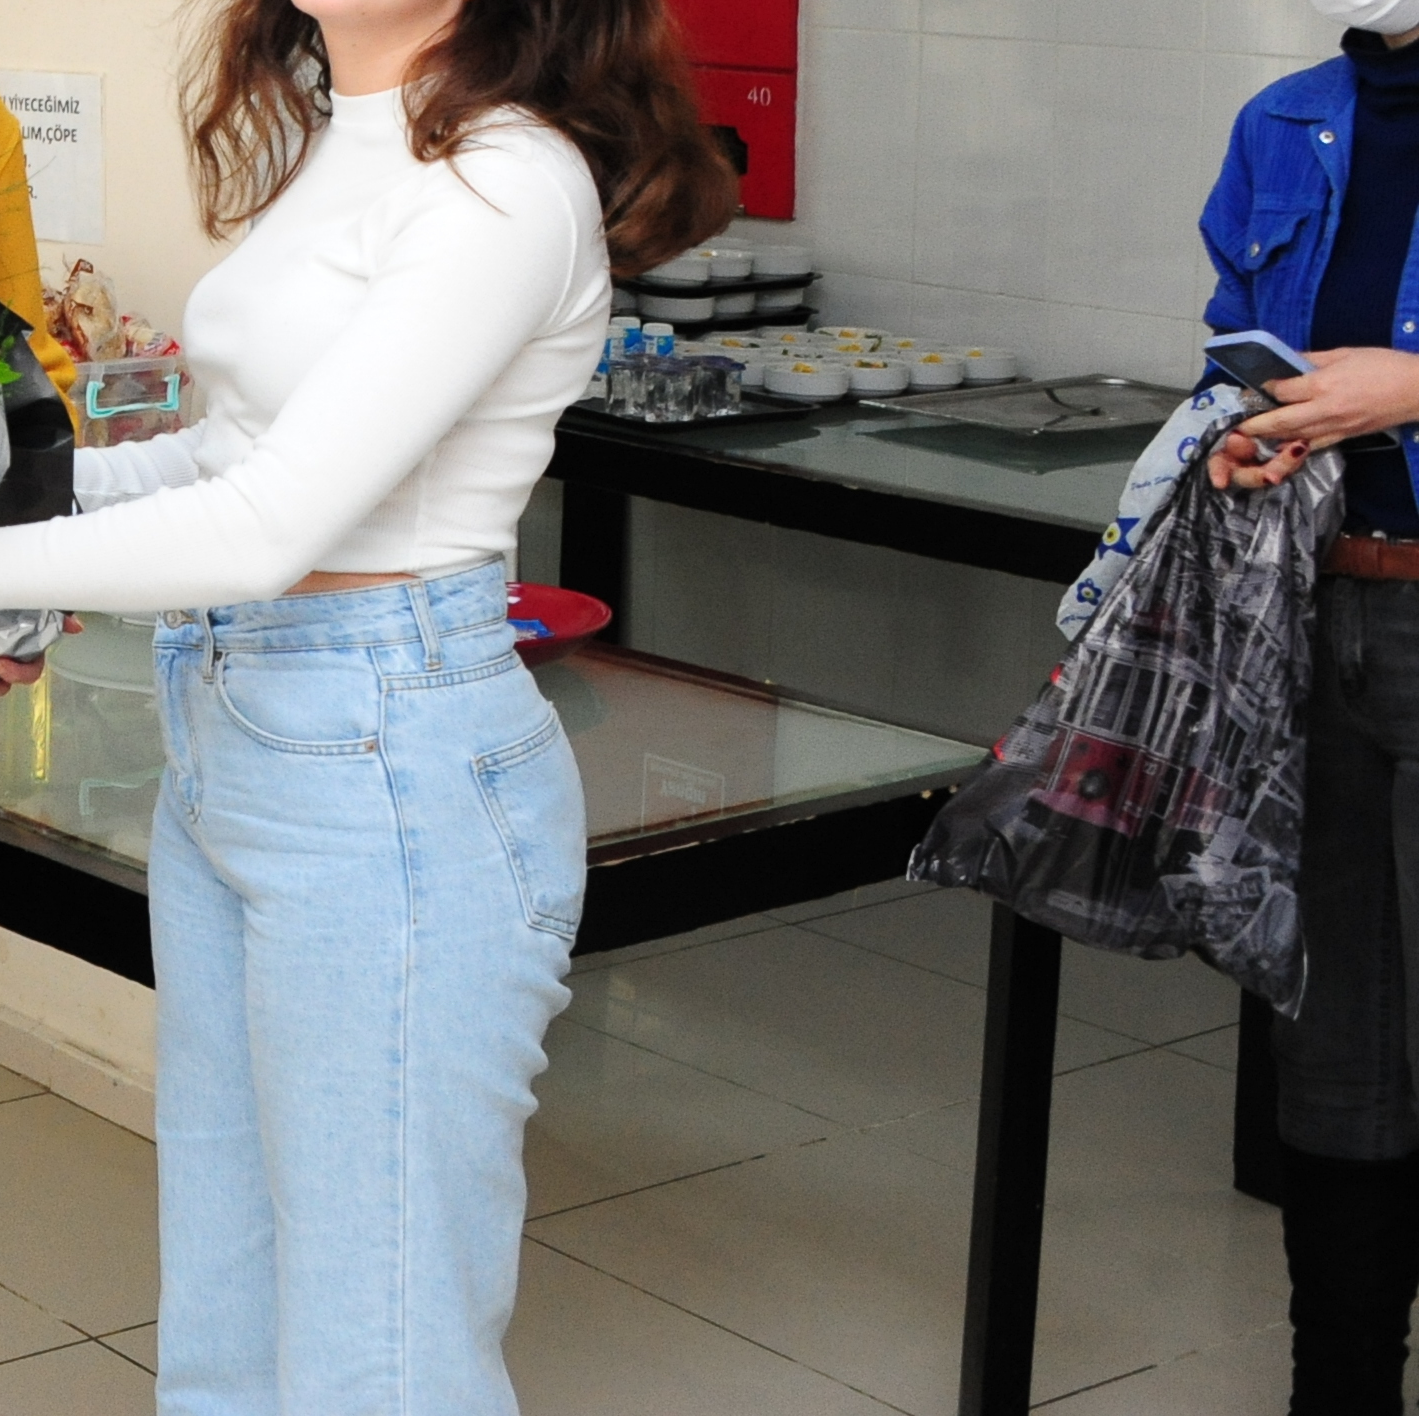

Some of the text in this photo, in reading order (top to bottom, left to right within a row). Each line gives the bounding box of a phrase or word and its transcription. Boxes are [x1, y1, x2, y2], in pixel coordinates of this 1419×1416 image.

[8, 94, 80, 114] YİYECEĞİMİZ
[747, 86, 772, 107] 40
[21, 125, 78, 144] LIM,ÇÖPE
